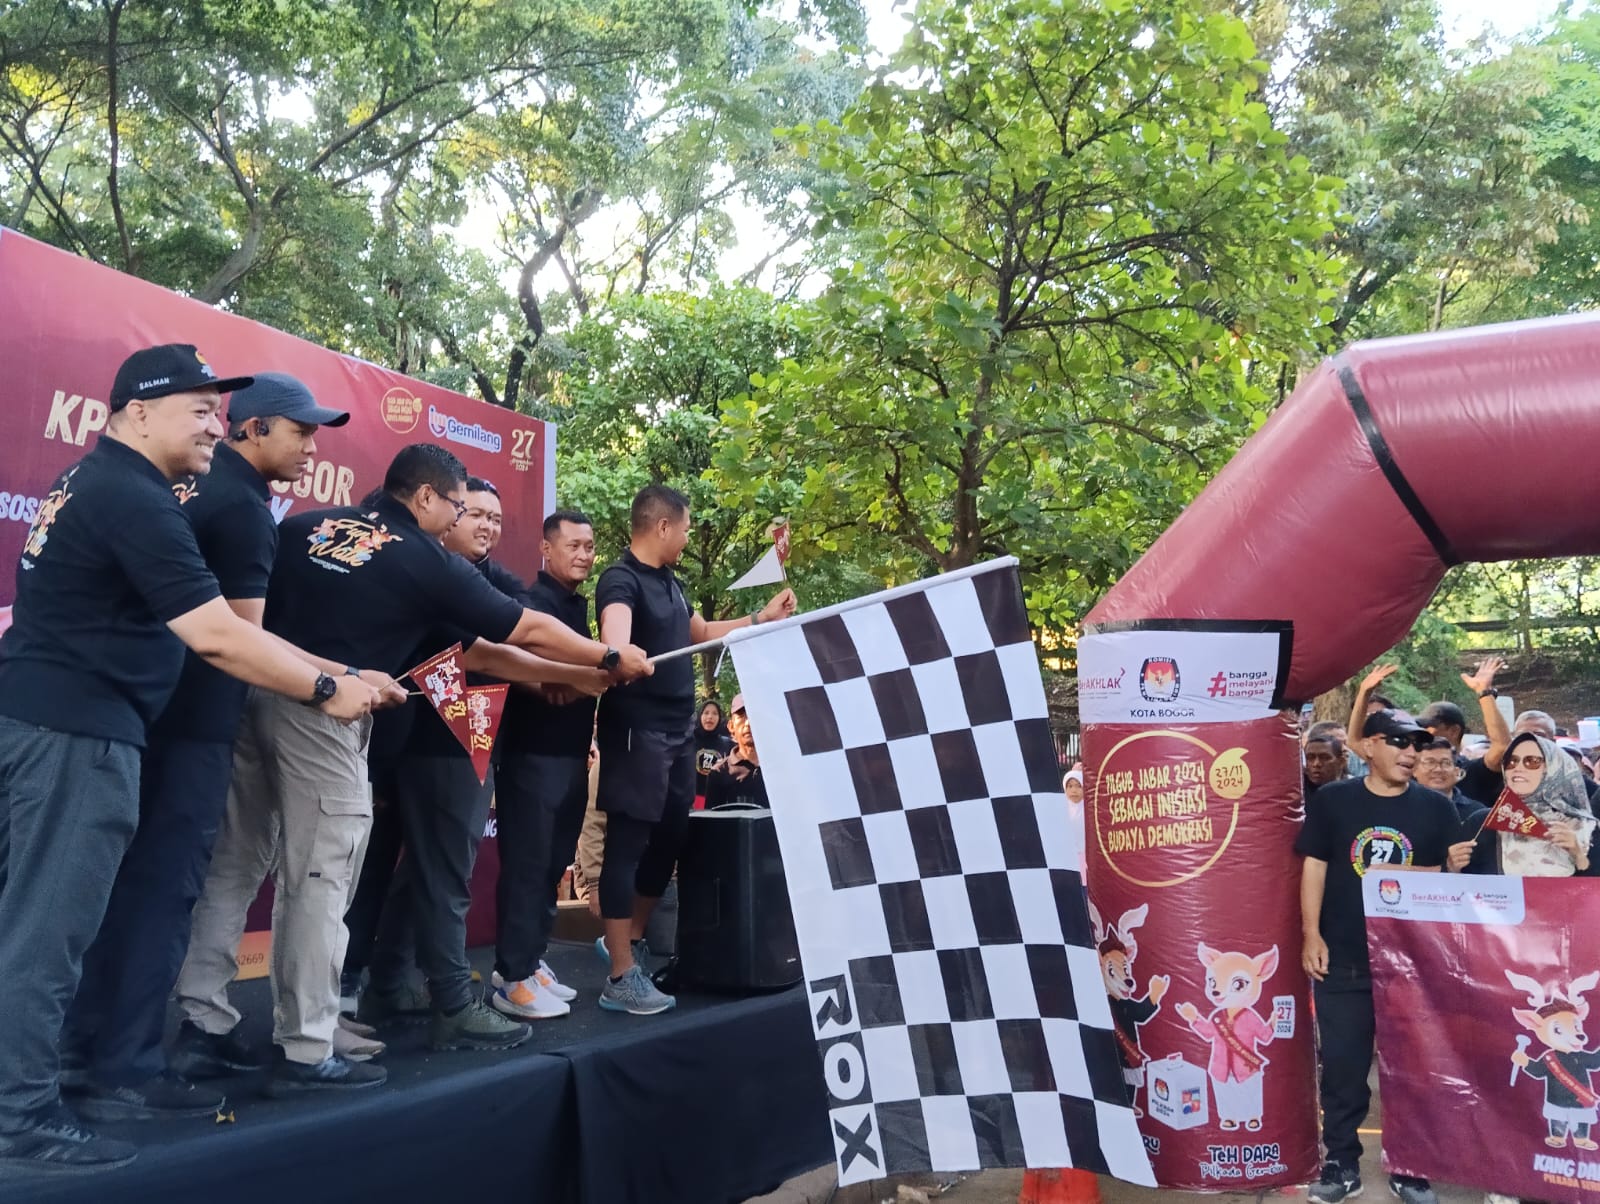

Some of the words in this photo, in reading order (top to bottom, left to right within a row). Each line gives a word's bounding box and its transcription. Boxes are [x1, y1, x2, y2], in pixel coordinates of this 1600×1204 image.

[138, 376, 170, 391] SALMAN
[447, 418, 501, 451] Gemilang
[510, 428, 537, 459] 27
[44, 389, 110, 447] KP
[271, 457, 355, 507] GOR
[0, 491, 41, 524] SOS
[1228, 671, 1268, 680] bangga
[1228, 676, 1274, 689] melayani
[1228, 688, 1265, 698] bangsa
[1130, 708, 1156, 719] KOTA
[1158, 708, 1195, 718] BOGOR
[1137, 764, 1171, 791] JABAR
[1173, 760, 1206, 786] 2024
[1215, 764, 1244, 779] 27/11
[1216, 776, 1244, 790] 2024
[1108, 793, 1154, 826] SEBAGAI
[1107, 825, 1146, 854] BUDAYA
[1147, 816, 1213, 849] DEMOKRASI
[1370, 846, 1394, 865] 27
[1276, 1006, 1292, 1020] 27
[1243, 1143, 1280, 1163] DARA
[1199, 1162, 1242, 1180] Pilkada
[1533, 1153, 1577, 1178] KANG
[1577, 1160, 1600, 1182] DA
